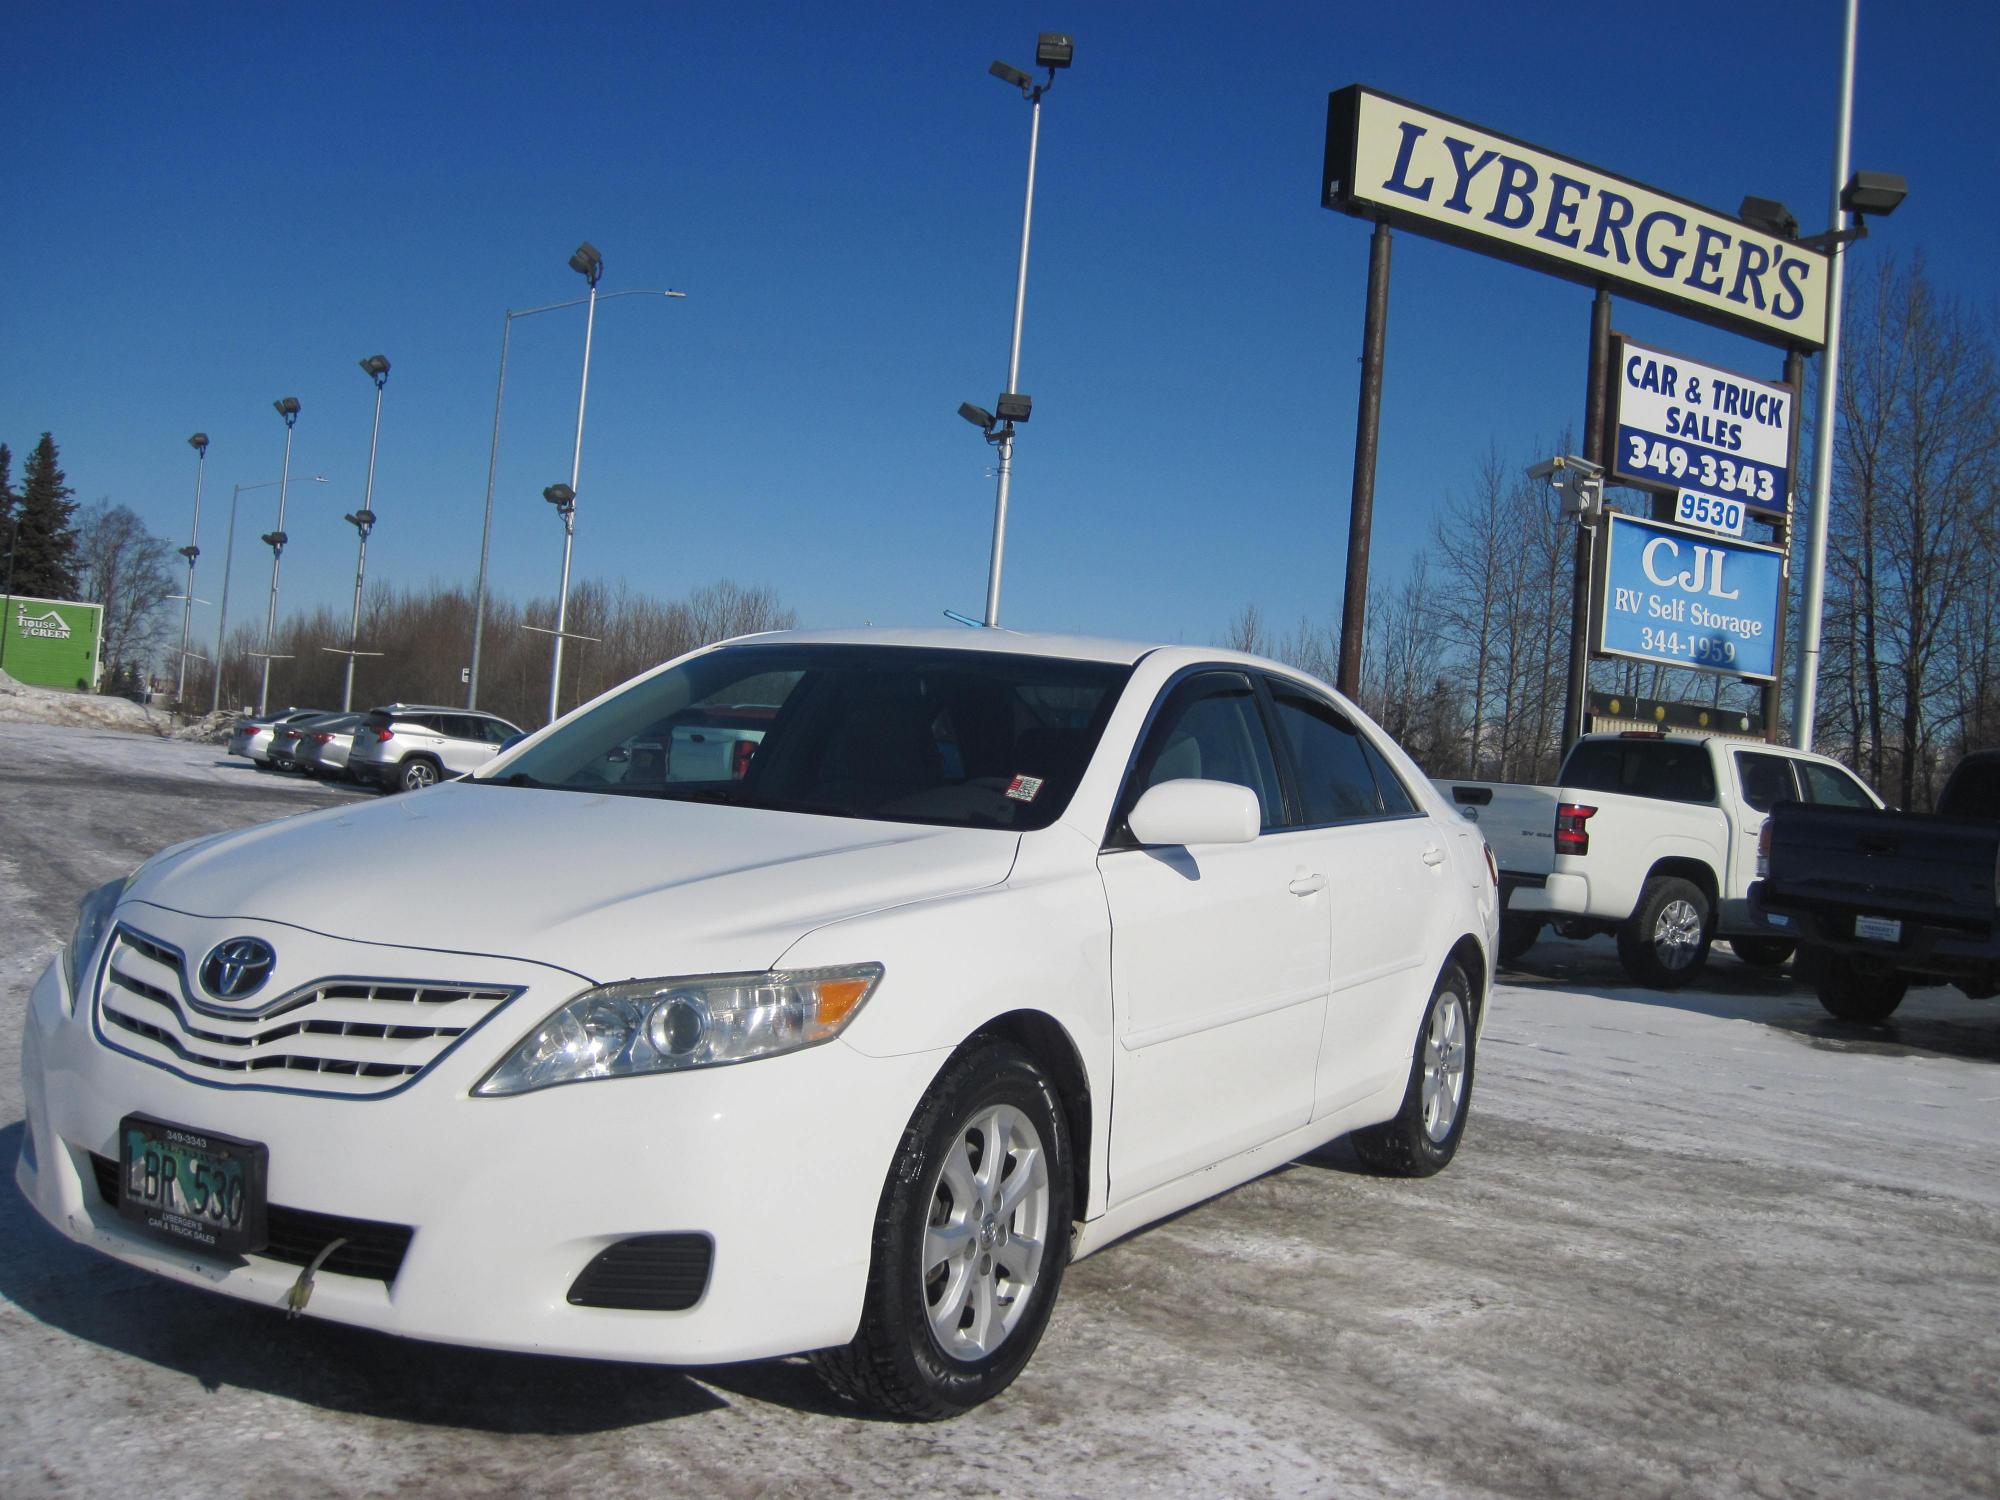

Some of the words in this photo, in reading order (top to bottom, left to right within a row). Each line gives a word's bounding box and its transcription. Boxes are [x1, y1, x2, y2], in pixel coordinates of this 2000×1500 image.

[1382, 121, 1810, 321] LYBERGER'S
[1626, 355, 1678, 398] CAR
[1685, 376, 1702, 405] &
[1712, 379, 1784, 428] TRUCK
[1665, 406, 1743, 451] SALES
[1628, 435, 1774, 501] 349-3343
[1680, 494, 1740, 530] 9530
[1641, 537, 1739, 600] CJL
[18, 616, 56, 628] house
[31, 629, 70, 639] GREEN
[1615, 587, 1643, 614] RV
[1648, 594, 1684, 622] Self
[1690, 602, 1763, 640] Storage
[1641, 627, 1736, 664] 344-1959
[166, 1129, 207, 1148] 349-3343
[194, 1164, 242, 1226] 530
[148, 1218, 163, 1230] CAR
[171, 1224, 193, 1237] TRUCK
[193, 1231, 215, 1244] SALES
